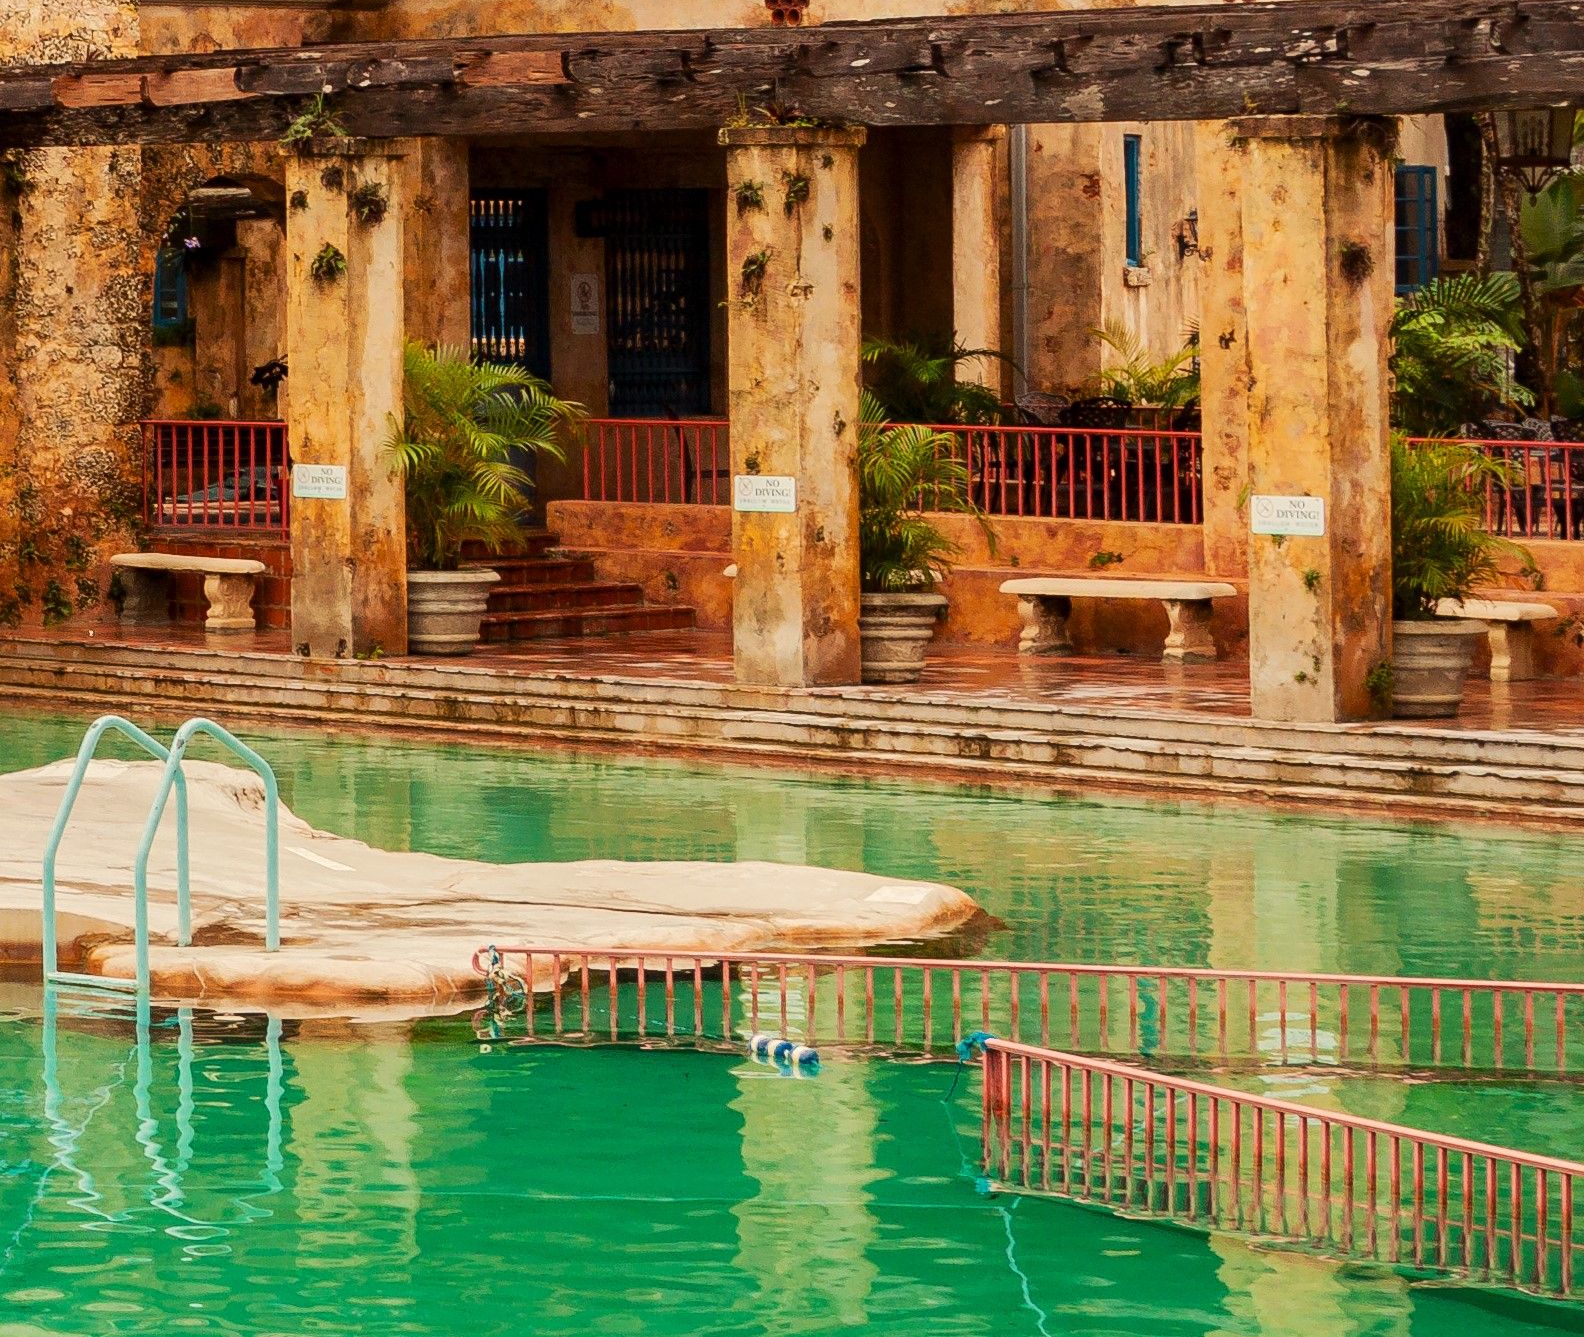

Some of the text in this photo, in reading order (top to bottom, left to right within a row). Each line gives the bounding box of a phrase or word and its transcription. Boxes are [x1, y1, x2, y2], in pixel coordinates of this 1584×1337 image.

[321, 467, 333, 476] NO
[765, 478, 780, 487] NO
[755, 487, 791, 497] DIVING!
[1288, 499, 1305, 510] NO
[1276, 509, 1320, 520] DIVING!
